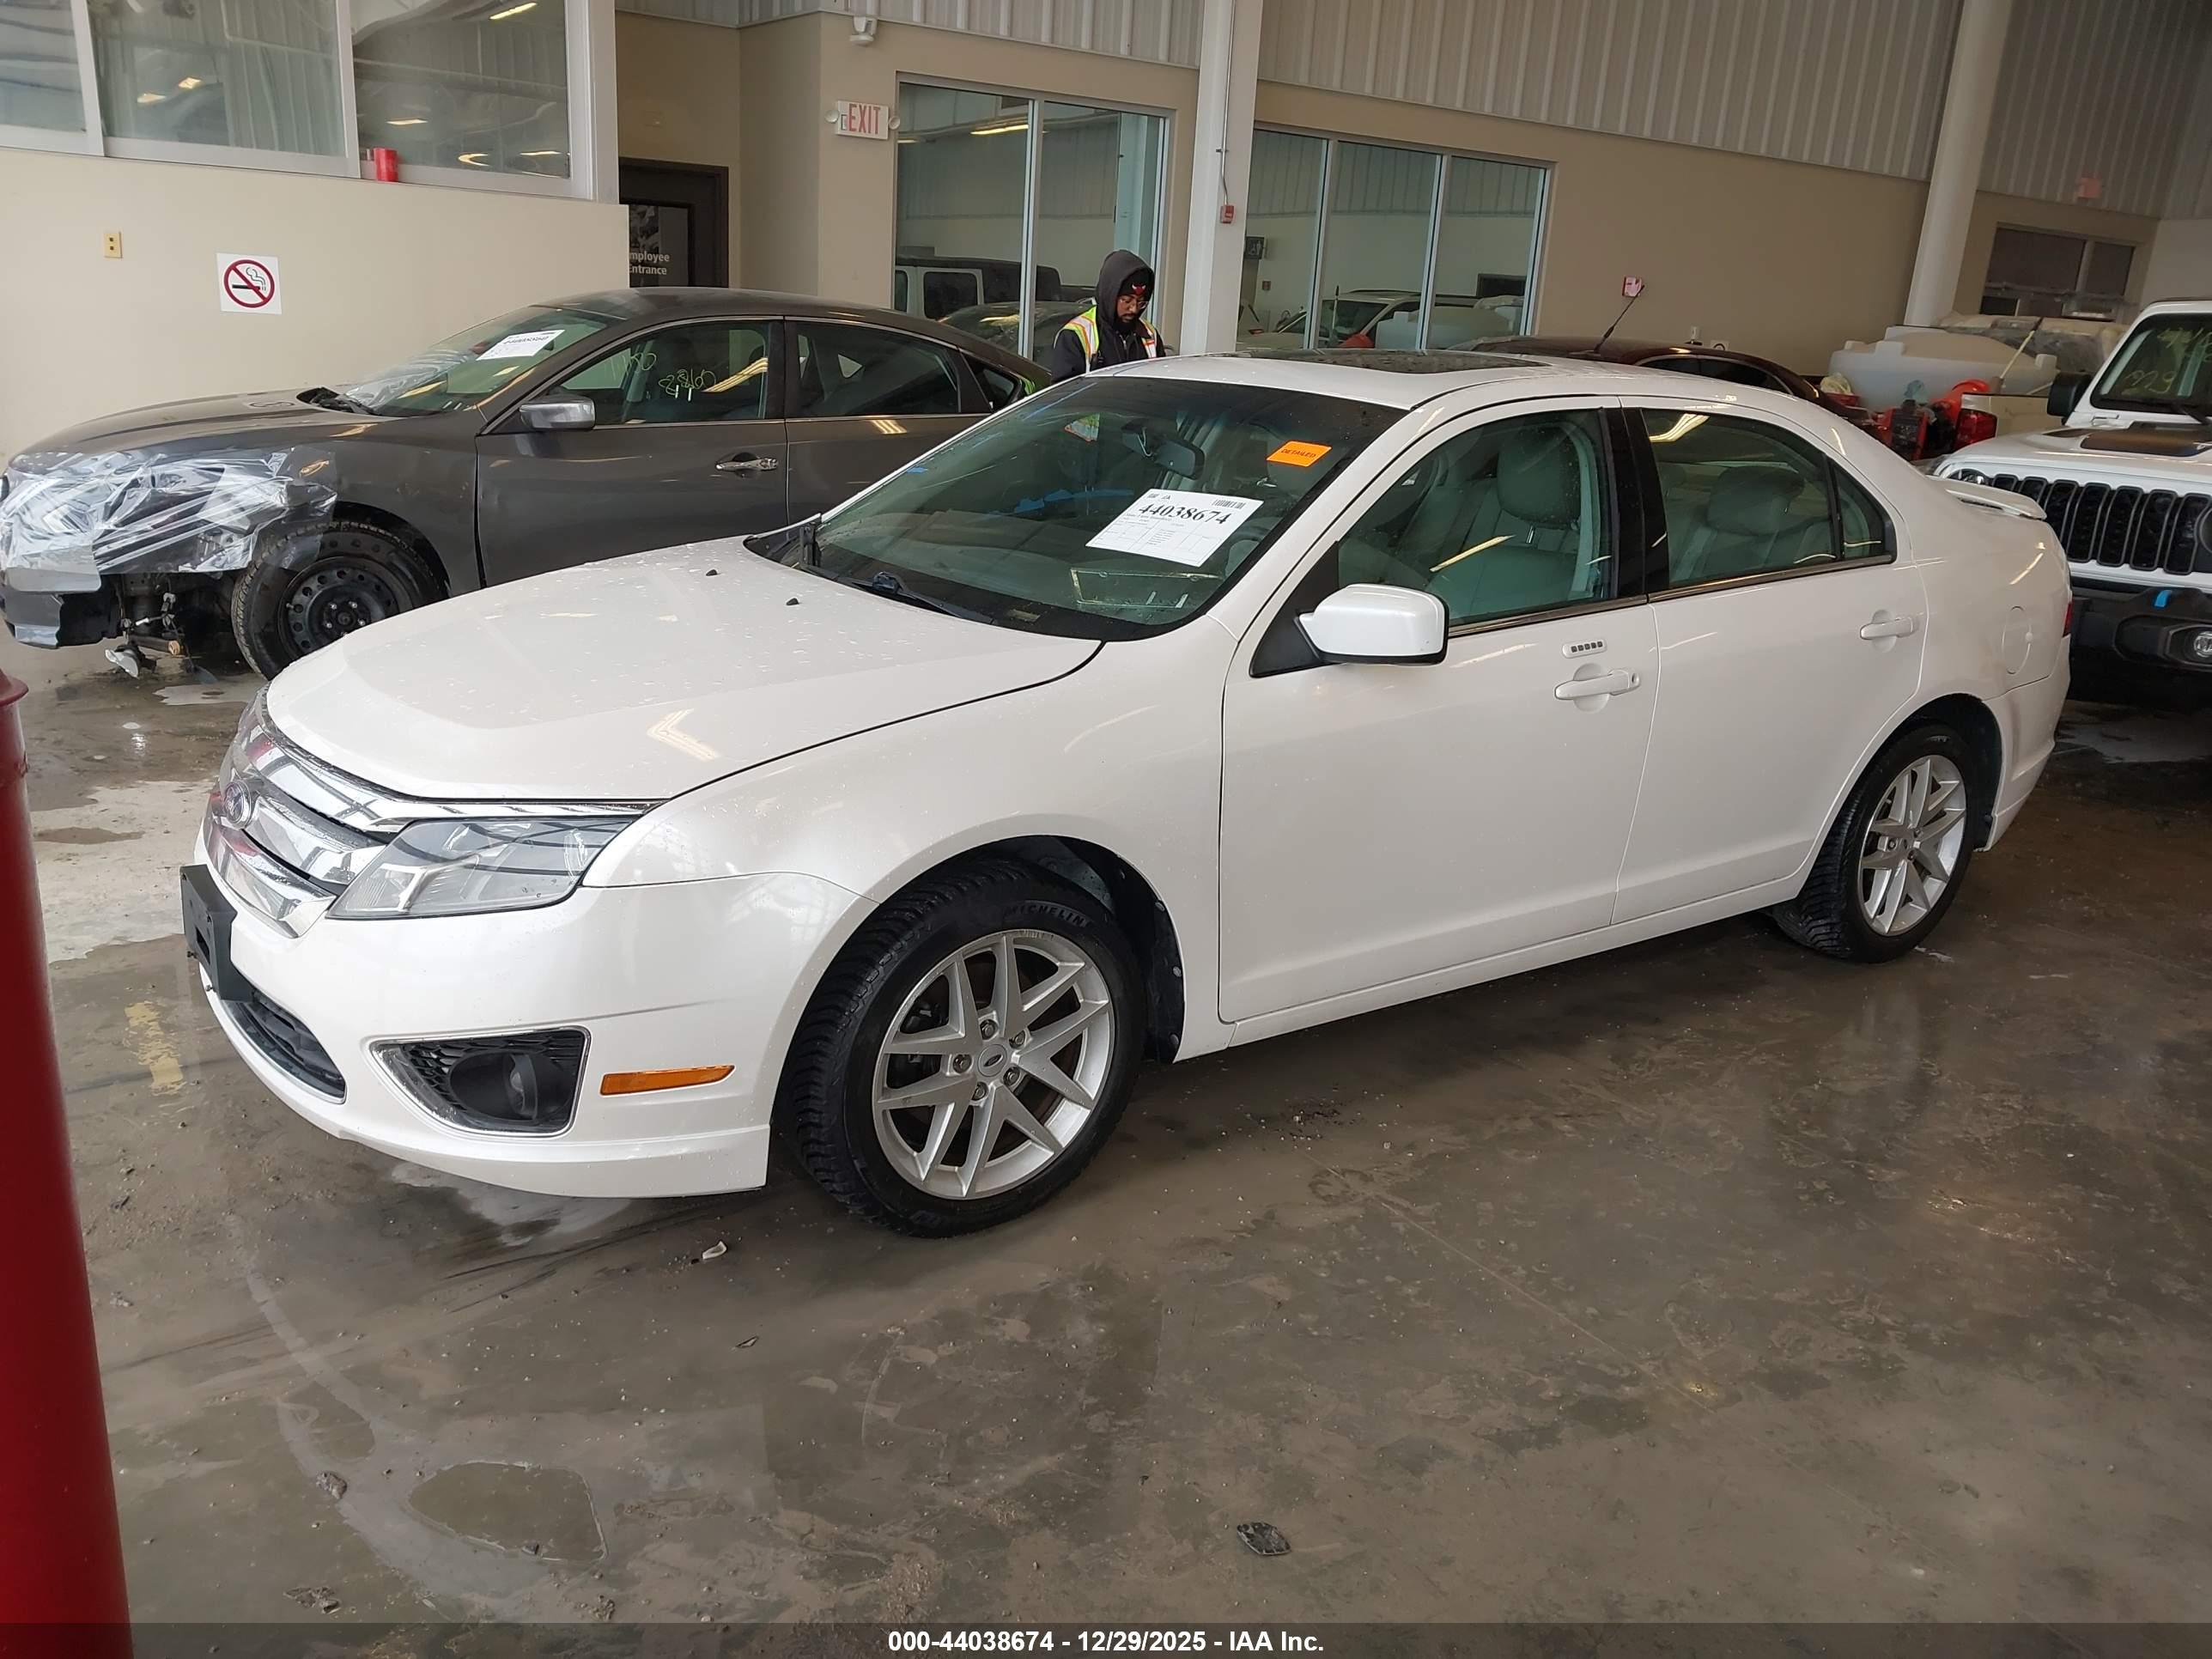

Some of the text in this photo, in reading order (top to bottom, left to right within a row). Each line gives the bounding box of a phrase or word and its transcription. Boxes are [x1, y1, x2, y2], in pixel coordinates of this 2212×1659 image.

[848, 103, 881, 134] EXIT
[629, 251, 670, 264] mployee
[1139, 503, 1232, 525] 44038674
